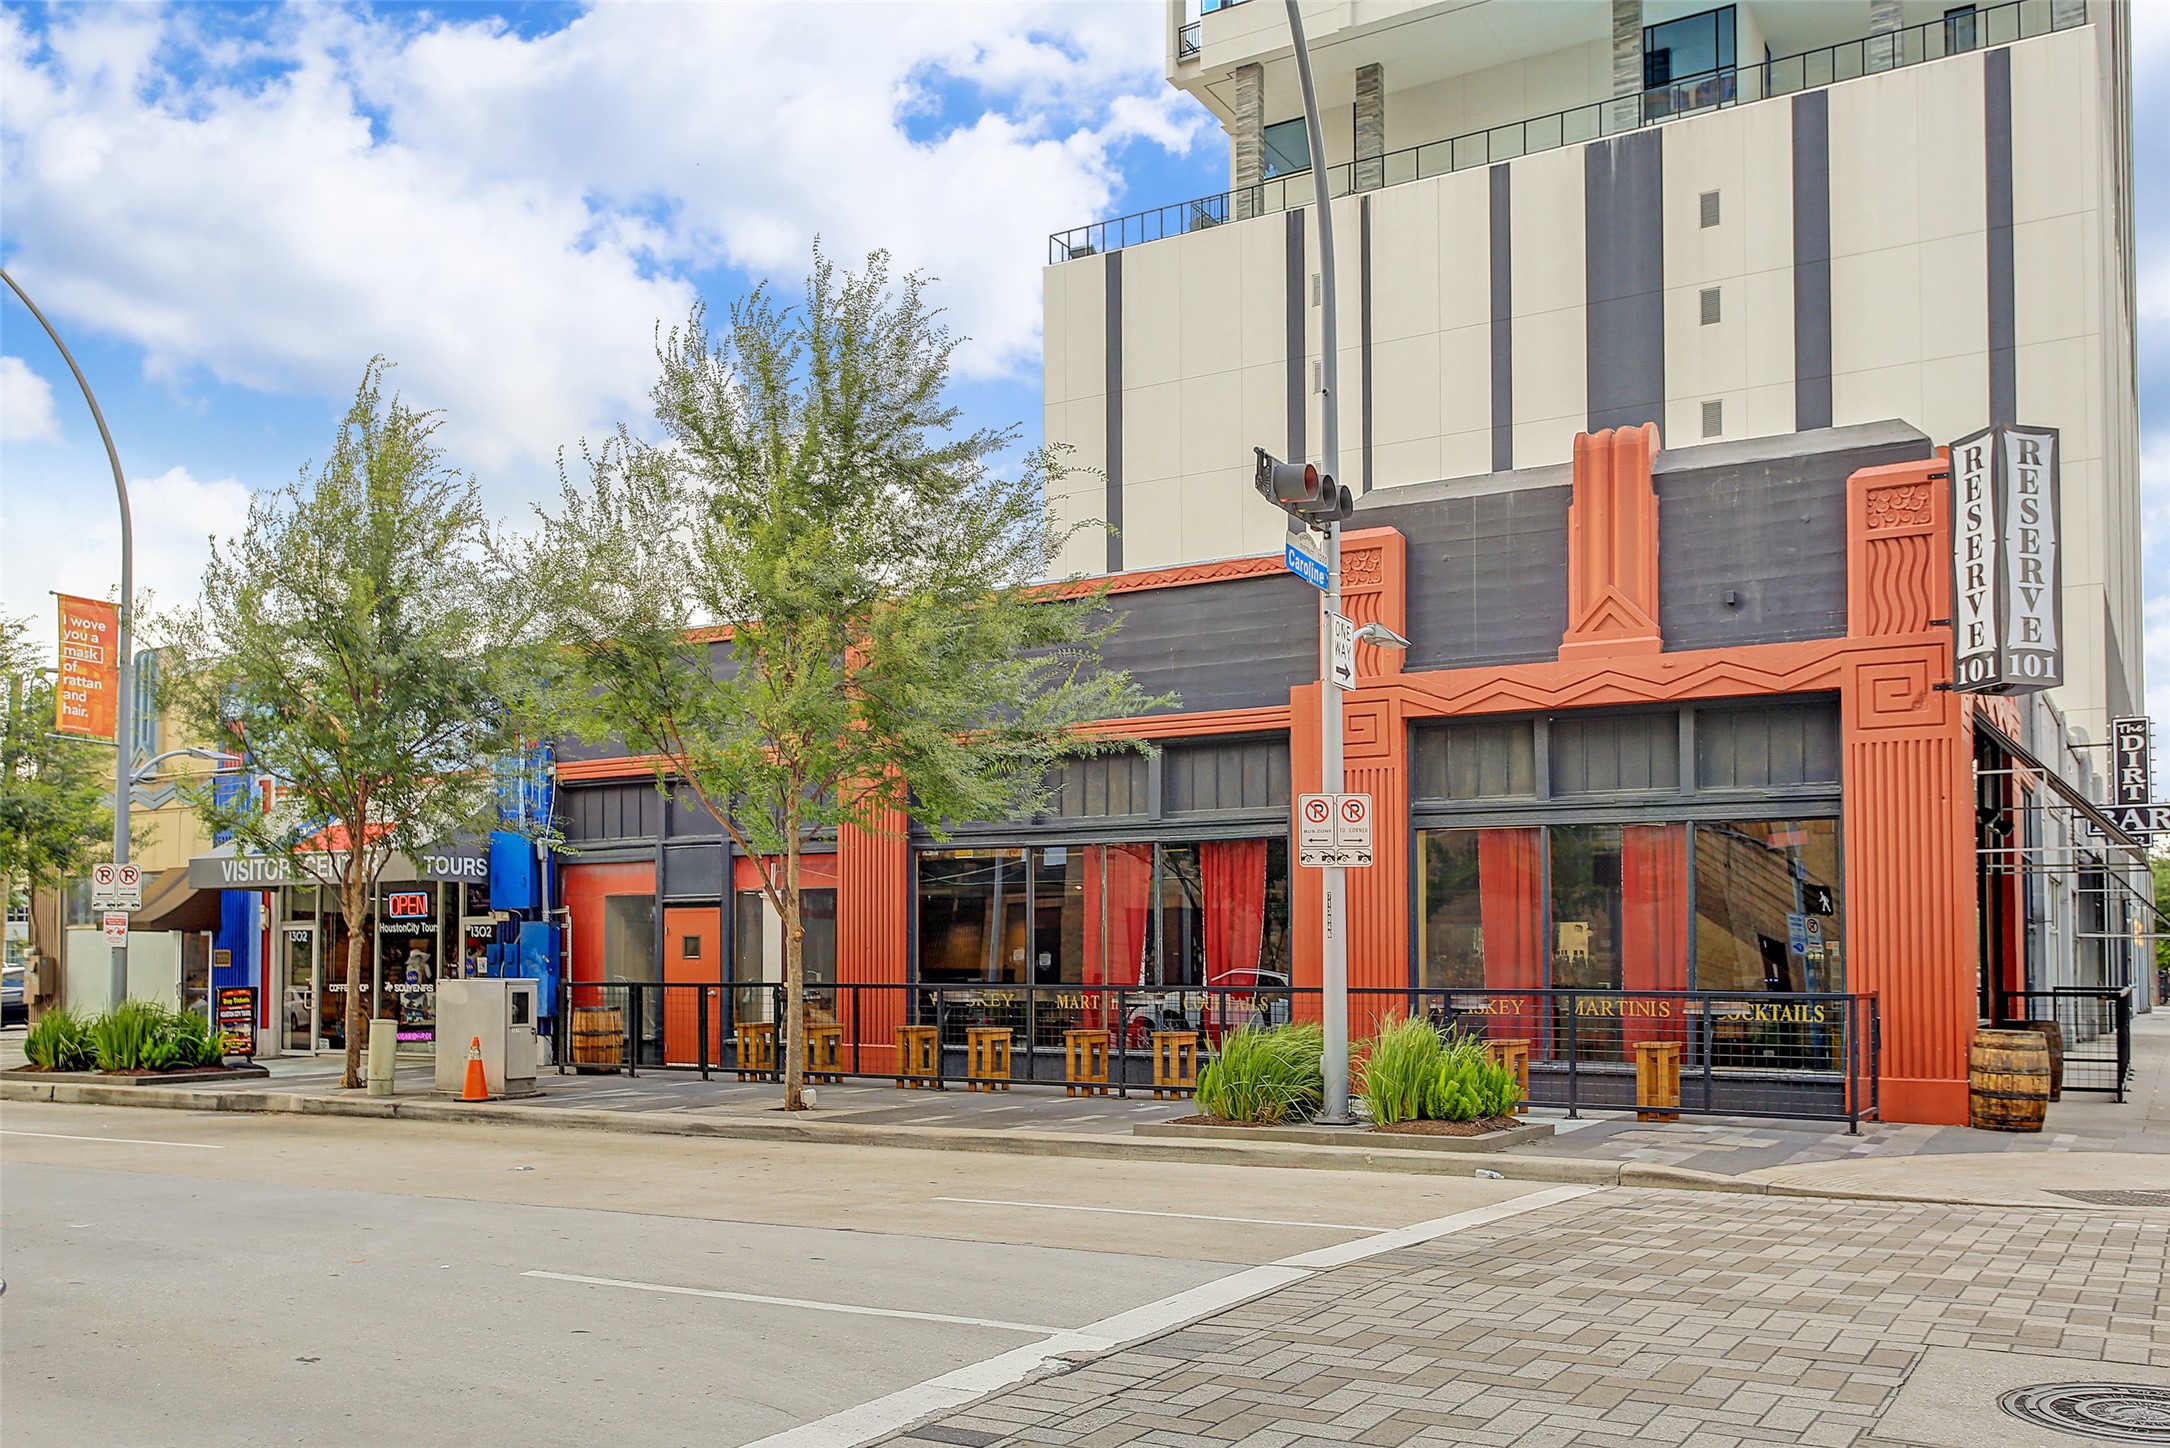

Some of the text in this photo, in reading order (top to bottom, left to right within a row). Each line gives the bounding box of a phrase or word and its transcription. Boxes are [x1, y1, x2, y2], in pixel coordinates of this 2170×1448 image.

[1963, 445, 1986, 650] RESERVE
[2016, 438, 2045, 644] RESERVE
[1288, 548, 1325, 585] Caroline
[63, 613, 107, 632] I wove
[1335, 621, 1351, 642] ONE
[63, 628, 99, 643] you a
[64, 646, 98, 661] mask
[1334, 640, 1352, 661] WAY
[63, 660, 78, 673] of
[1957, 655, 1997, 685] 101
[2009, 653, 2057, 679] 101
[63, 675, 103, 690] rattan
[63, 689, 87, 703] and
[62, 702, 89, 718] hair.
[2117, 723, 2145, 735] The
[2120, 734, 2146, 801] DIRT
[304, 854, 380, 879] CENTR
[422, 855, 488, 877] TOURS
[391, 894, 427, 916] OPEN
[288, 931, 308, 942] 1302
[469, 925, 492, 938] 1302
[1567, 999, 1671, 1018] MARTINIS
